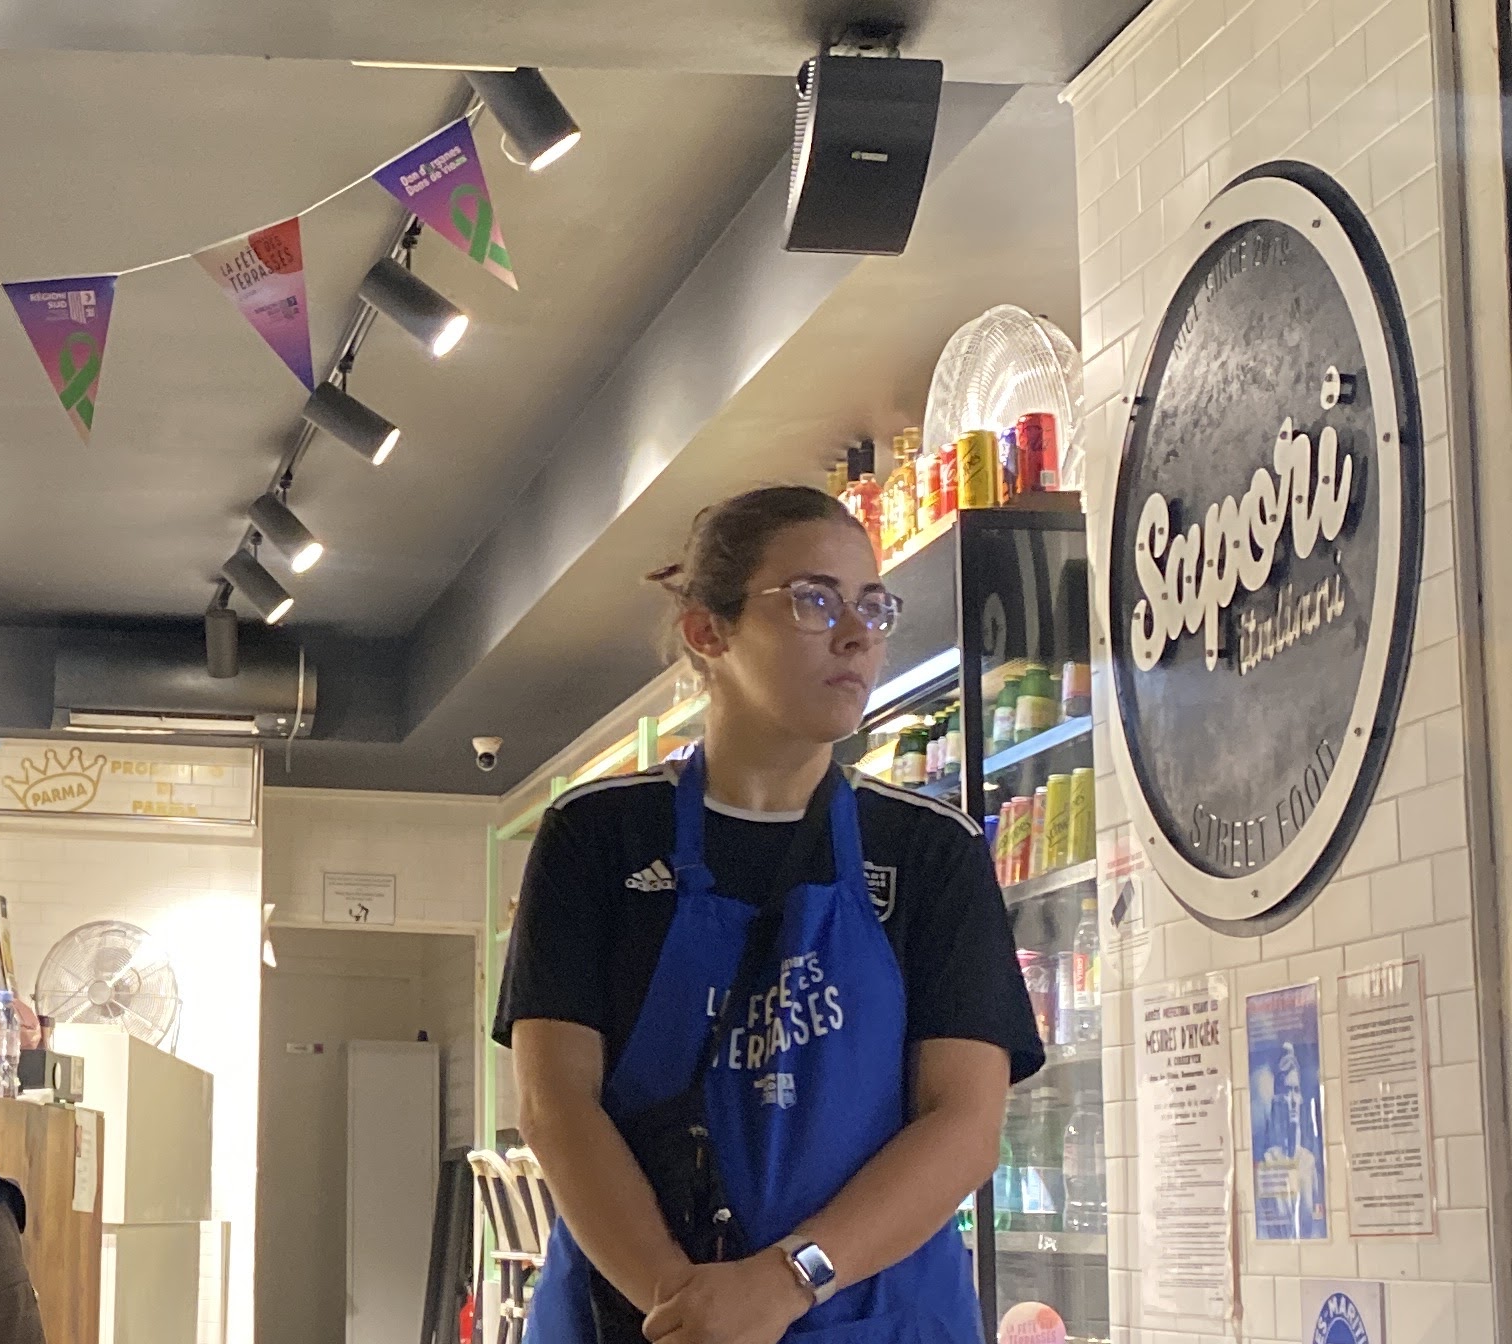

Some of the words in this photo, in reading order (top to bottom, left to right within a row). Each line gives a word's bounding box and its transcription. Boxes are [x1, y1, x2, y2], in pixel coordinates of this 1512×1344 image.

[220, 263, 233, 277] LA
[229, 246, 294, 293] TERRASSES
[48, 300, 67, 309] SUD
[1131, 365, 1353, 671] Sapori
[1240, 549, 1345, 676] italiani
[31, 783, 87, 807] PARMA
[1190, 803, 1267, 868] STREET
[1277, 738, 1335, 848] FOOD
